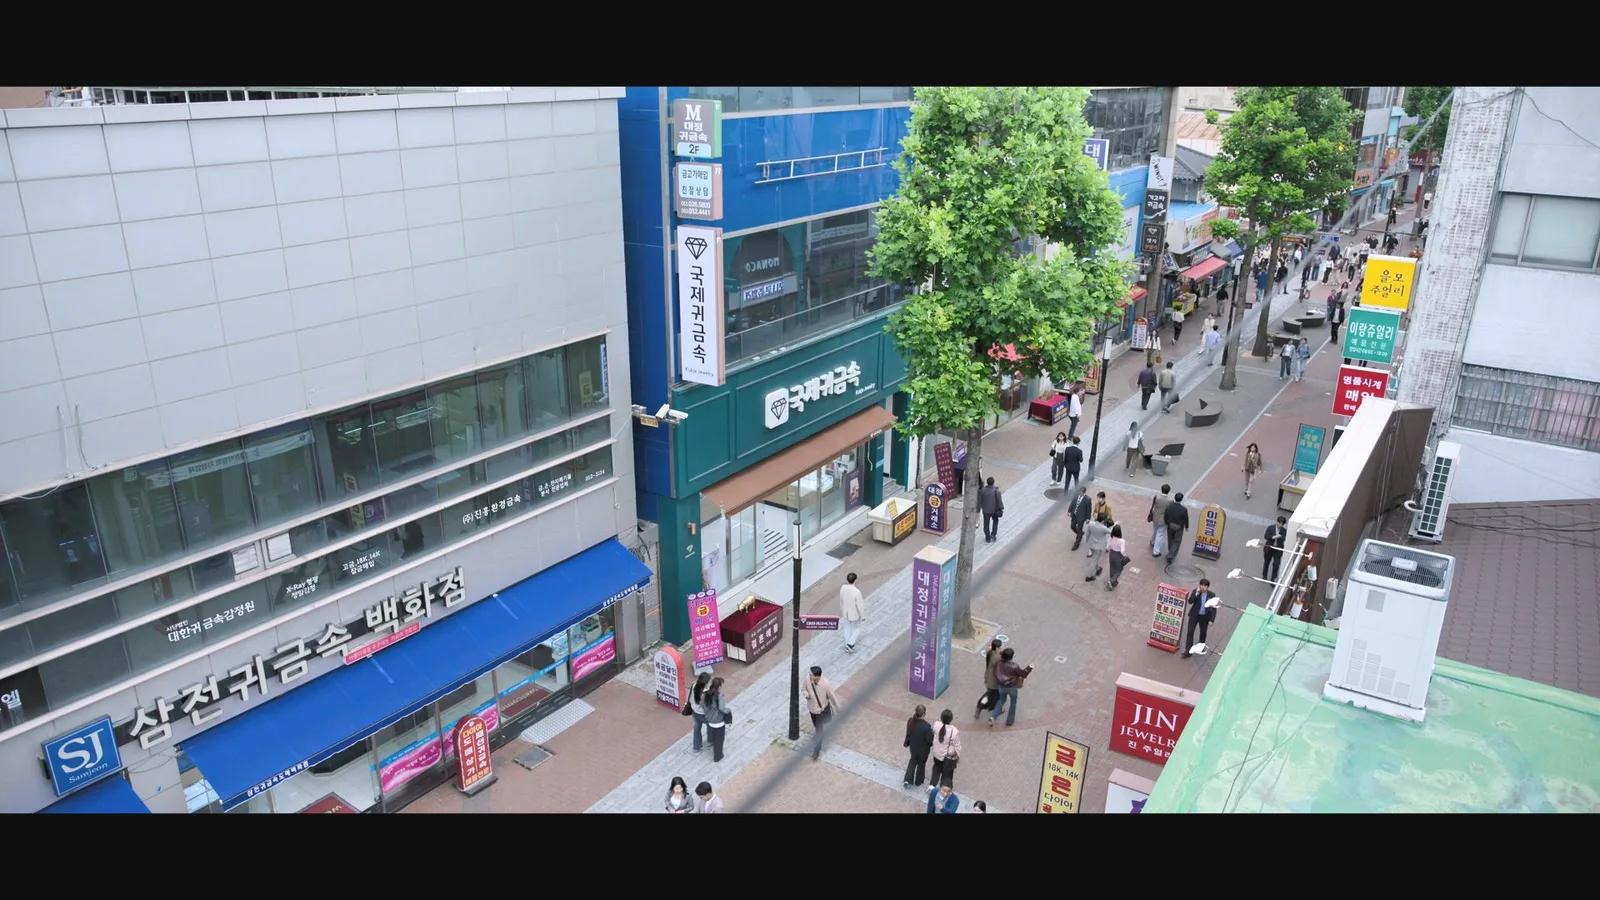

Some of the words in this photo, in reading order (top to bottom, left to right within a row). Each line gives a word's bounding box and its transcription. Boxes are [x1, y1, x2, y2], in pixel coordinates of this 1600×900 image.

[685, 104, 702, 121] M
[679, 131, 708, 142] 귀금속
[683, 121, 703, 132] 대정
[689, 144, 700, 154] 2F
[1370, 284, 1405, 299] 주얼리
[690, 265, 707, 364] 국제귀금속
[1350, 321, 1395, 341] 이랑쥬얼리
[789, 360, 861, 412] 국제귀금속
[1343, 374, 1383, 390] 명품시계
[930, 508, 939, 529] 거래소
[286, 581, 305, 595] X-Ray
[167, 600, 256, 643] 대한귀금속감정원
[129, 621, 353, 751] 삼전귀금속
[363, 565, 466, 634] 백화점
[1130, 703, 1179, 732] JIN
[1120, 724, 1177, 748] JEWELR
[57, 728, 104, 774] SJ
[1055, 743, 1077, 768] 금
[69, 762, 108, 785] Samjeon
[1051, 774, 1072, 798] 은
[1044, 792, 1074, 811] 다이아
